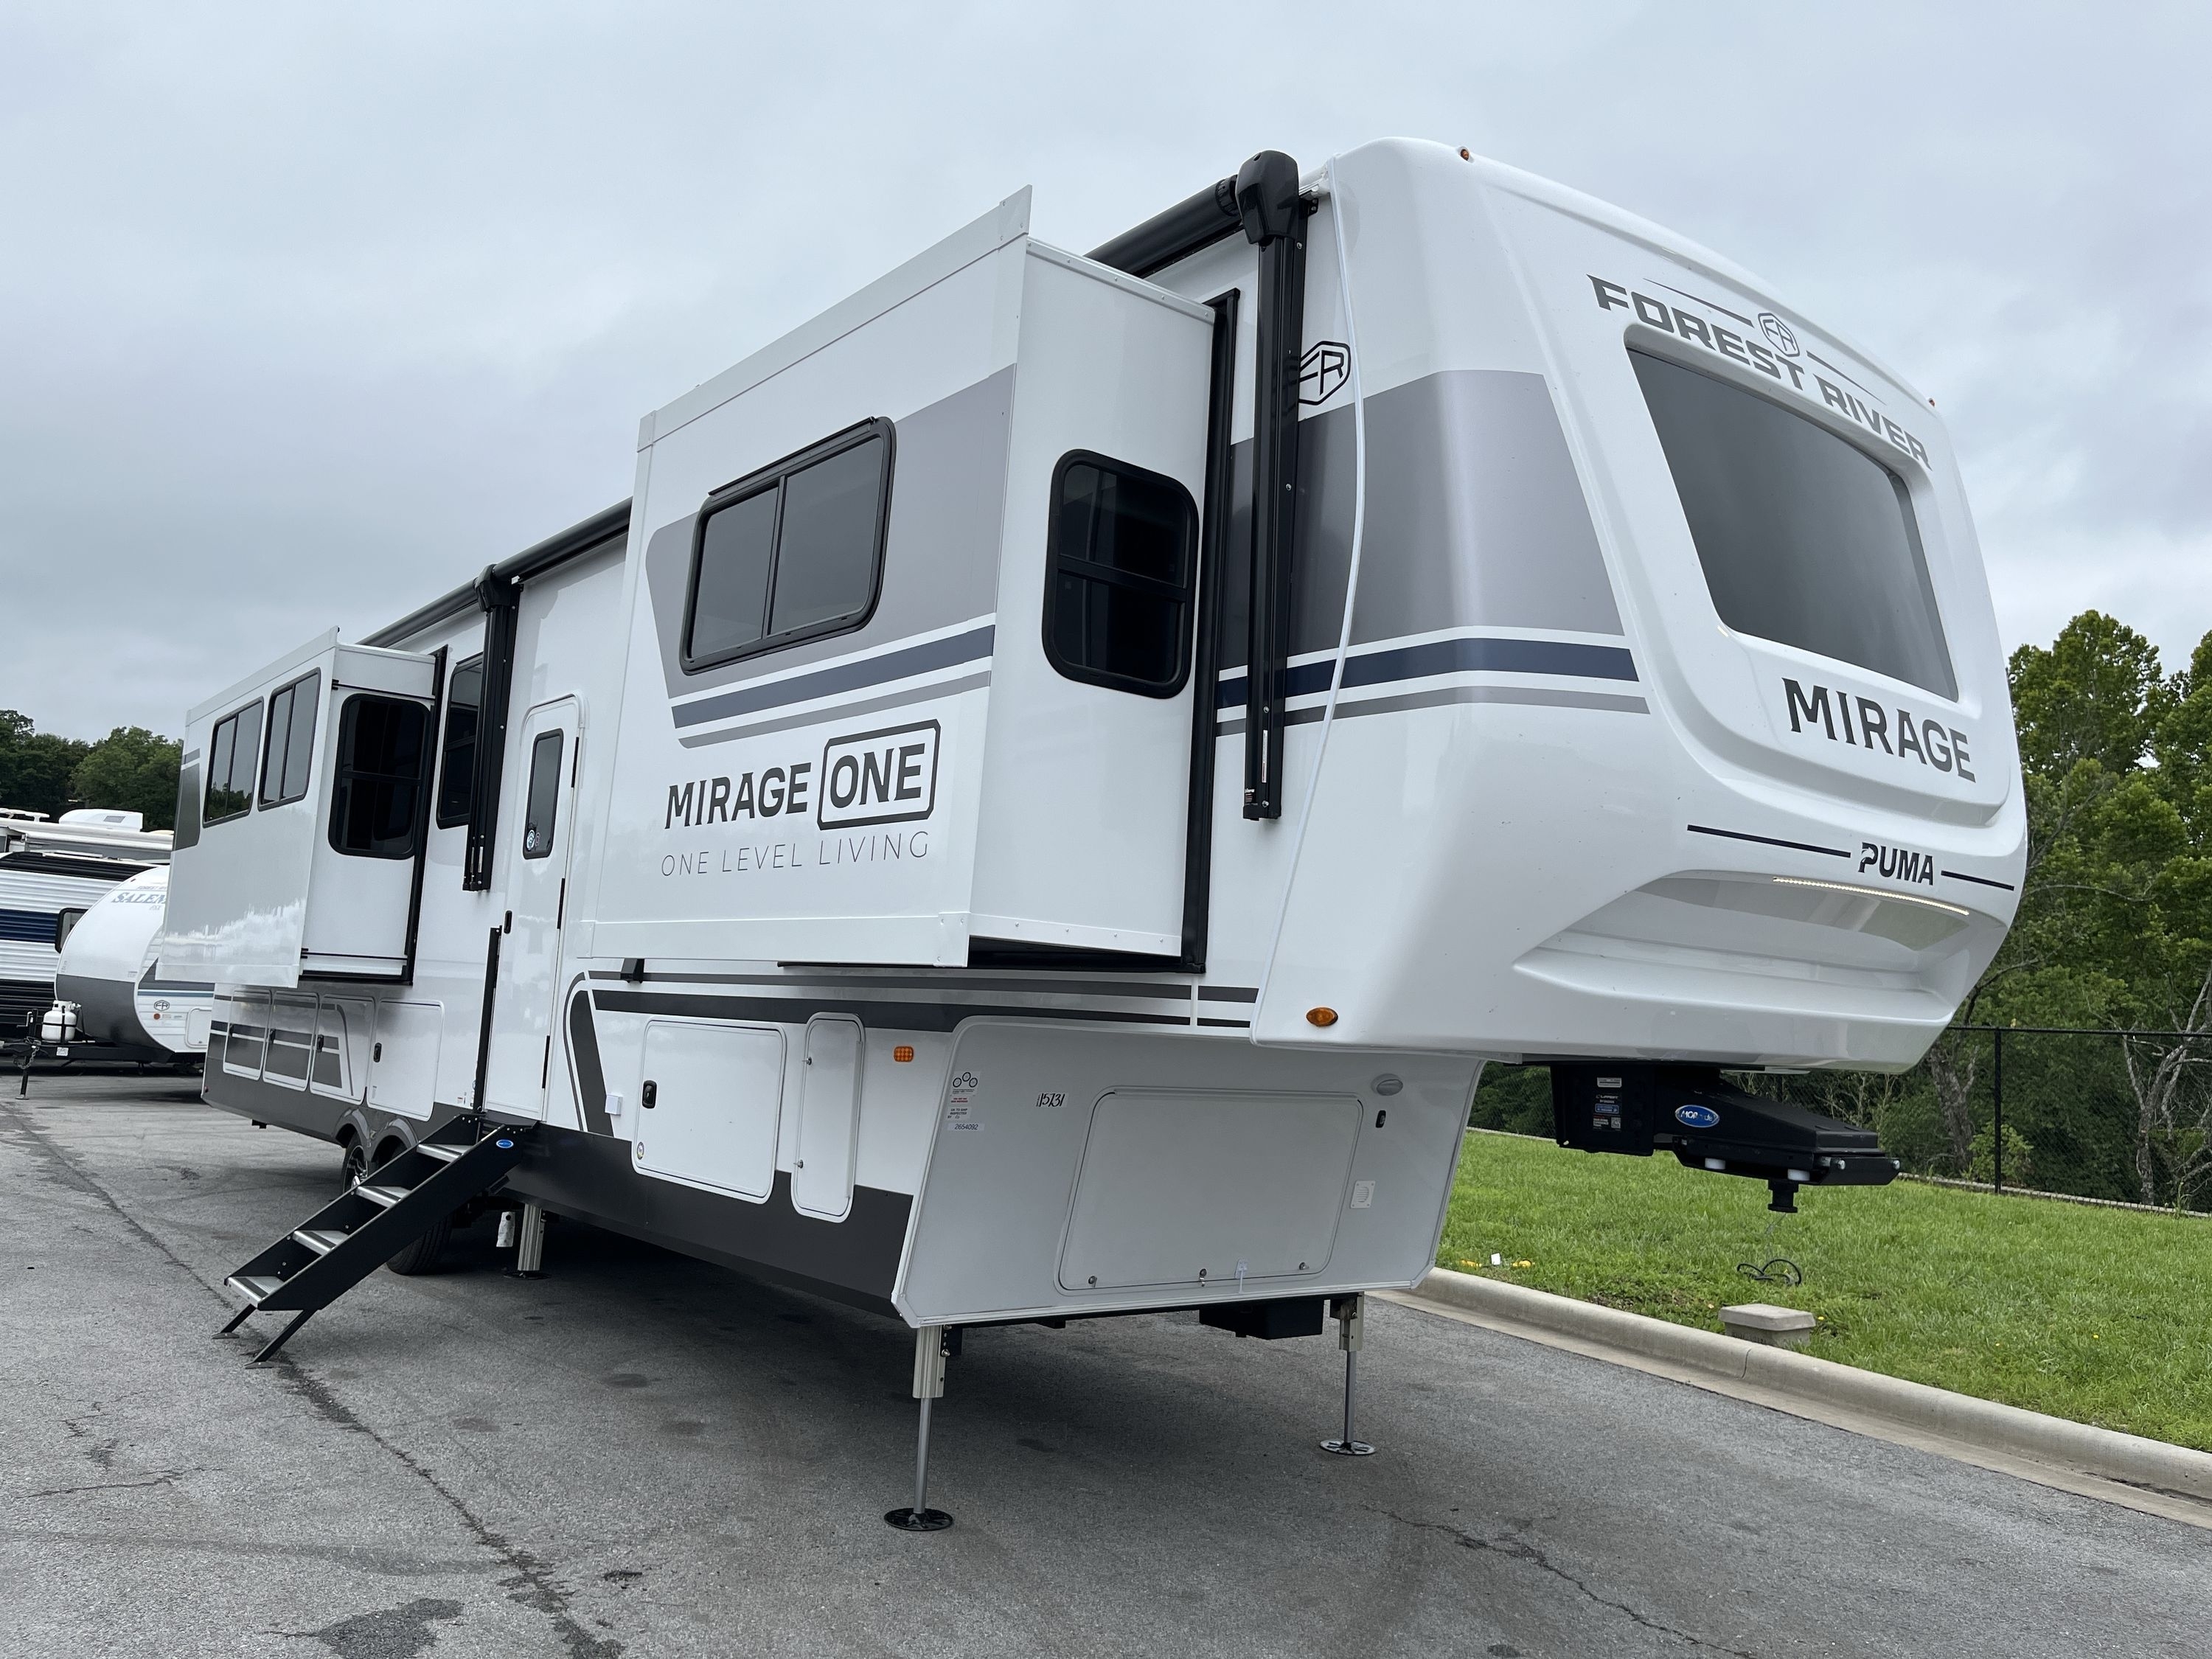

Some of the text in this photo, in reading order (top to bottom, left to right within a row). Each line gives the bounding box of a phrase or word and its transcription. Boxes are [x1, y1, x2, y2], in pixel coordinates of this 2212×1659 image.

[1586, 274, 1933, 471] FOREST RIVER
[1781, 677, 1977, 783] MIRAGE
[664, 742, 926, 830] MIRAGE ONE
[661, 830, 929, 877] ONE LEVEL LIVING
[1857, 842, 1934, 886] PUMA
